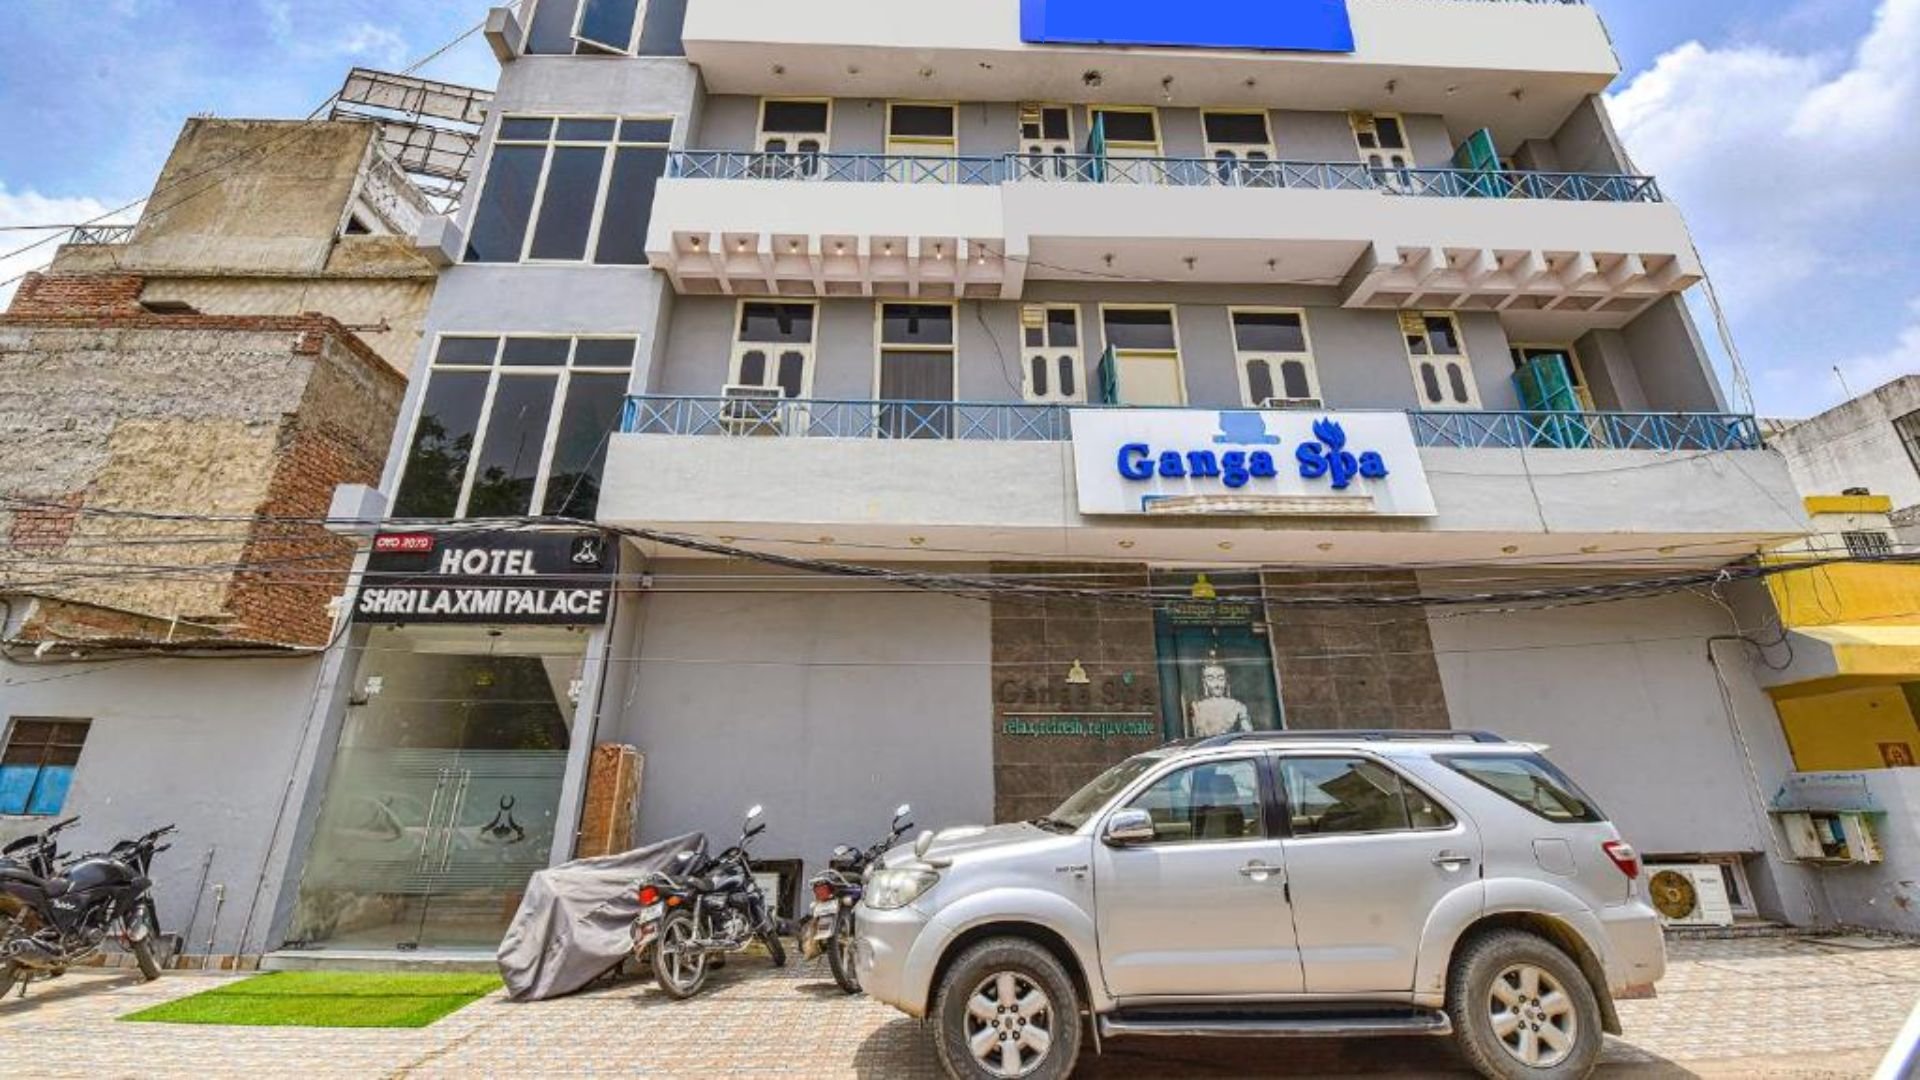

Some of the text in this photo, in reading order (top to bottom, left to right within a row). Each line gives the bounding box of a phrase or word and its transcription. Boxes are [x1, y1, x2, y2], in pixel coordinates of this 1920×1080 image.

[1117, 440, 1389, 489] Ganga Spa
[439, 549, 537, 575] HOTEL
[504, 590, 602, 614] PALACE
